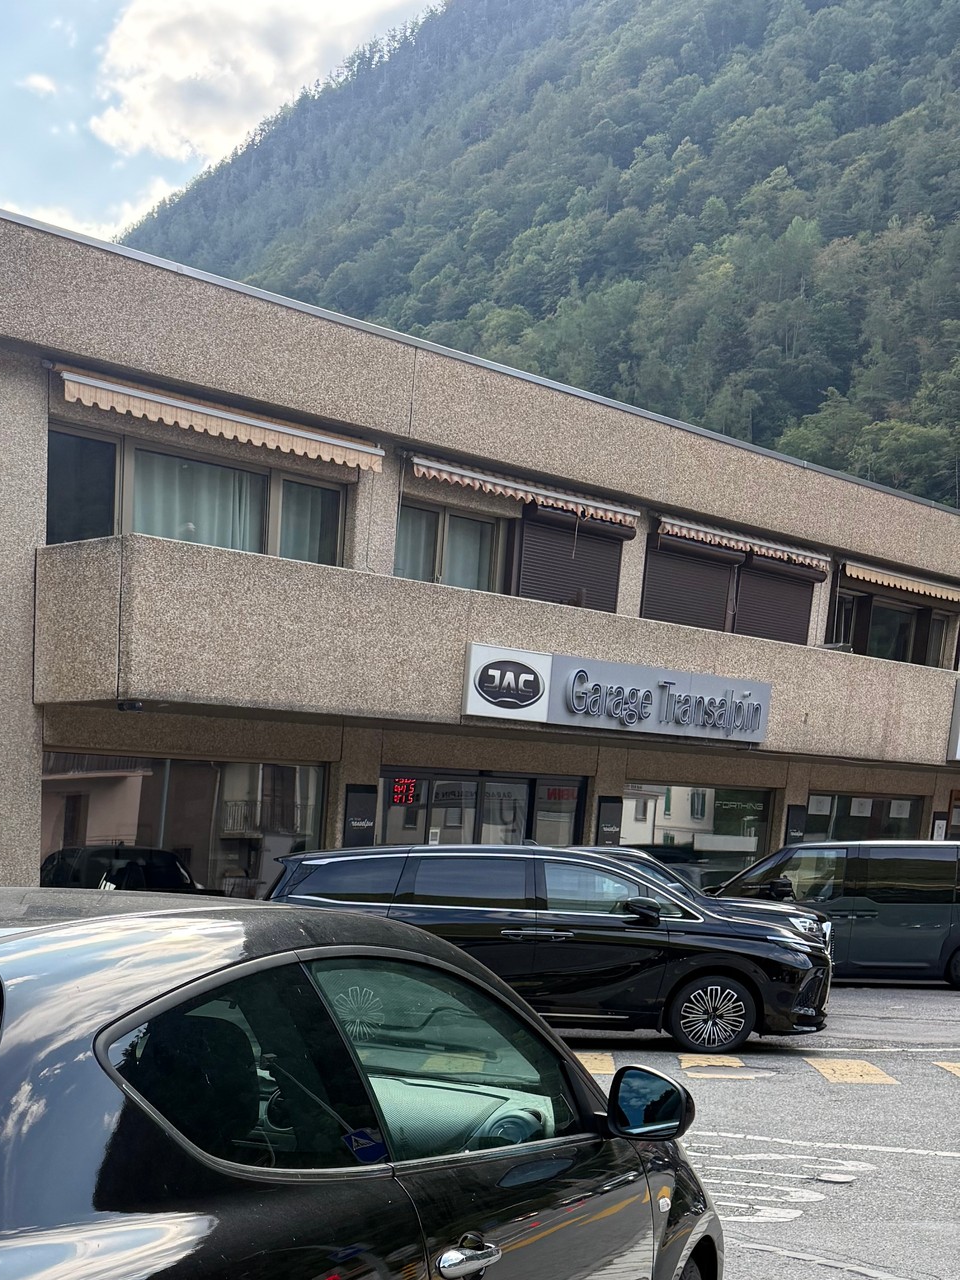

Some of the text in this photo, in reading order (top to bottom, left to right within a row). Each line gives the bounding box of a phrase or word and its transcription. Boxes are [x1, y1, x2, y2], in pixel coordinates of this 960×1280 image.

[483, 668, 535, 694] JAC
[567, 668, 763, 737] Garage Transalpin
